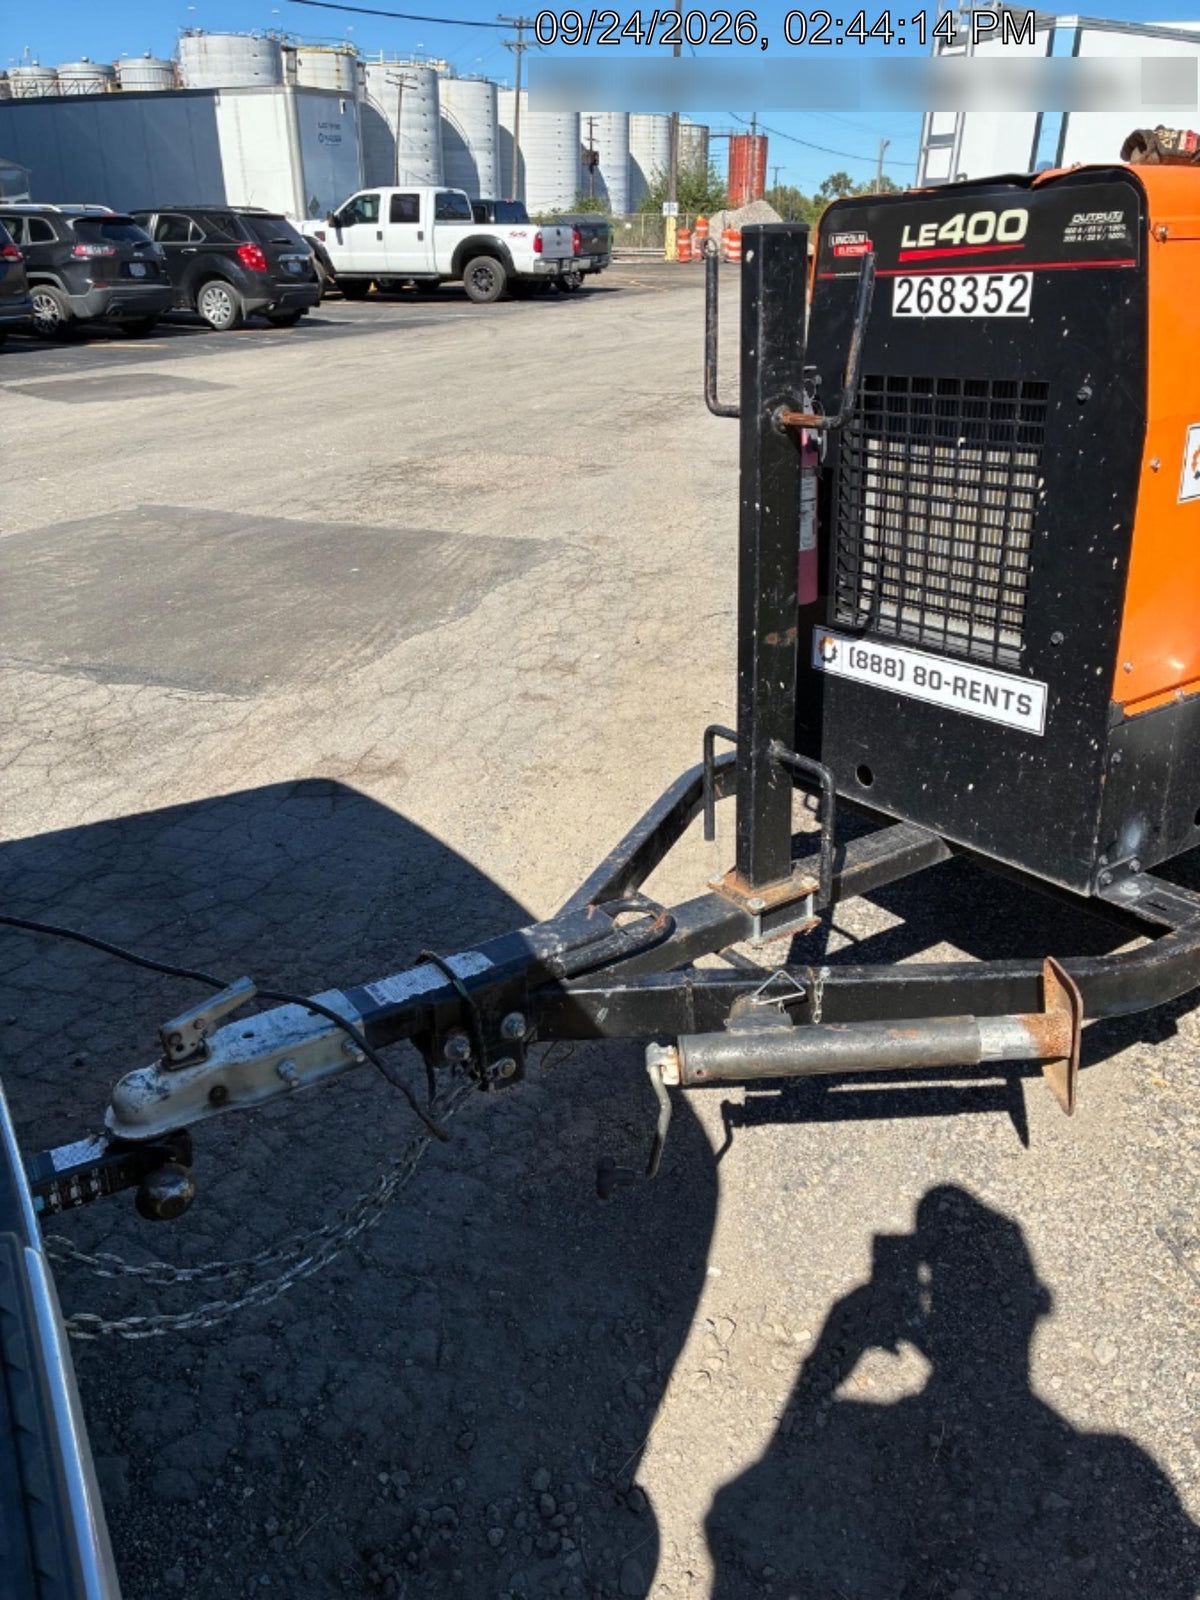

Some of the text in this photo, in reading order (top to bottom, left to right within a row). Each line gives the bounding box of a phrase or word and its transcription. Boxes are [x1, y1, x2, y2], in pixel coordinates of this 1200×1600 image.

[900, 208, 1029, 248] LE400
[895, 274, 1029, 314] 268352
[849, 646, 1032, 716] (888) 80-RENTS
